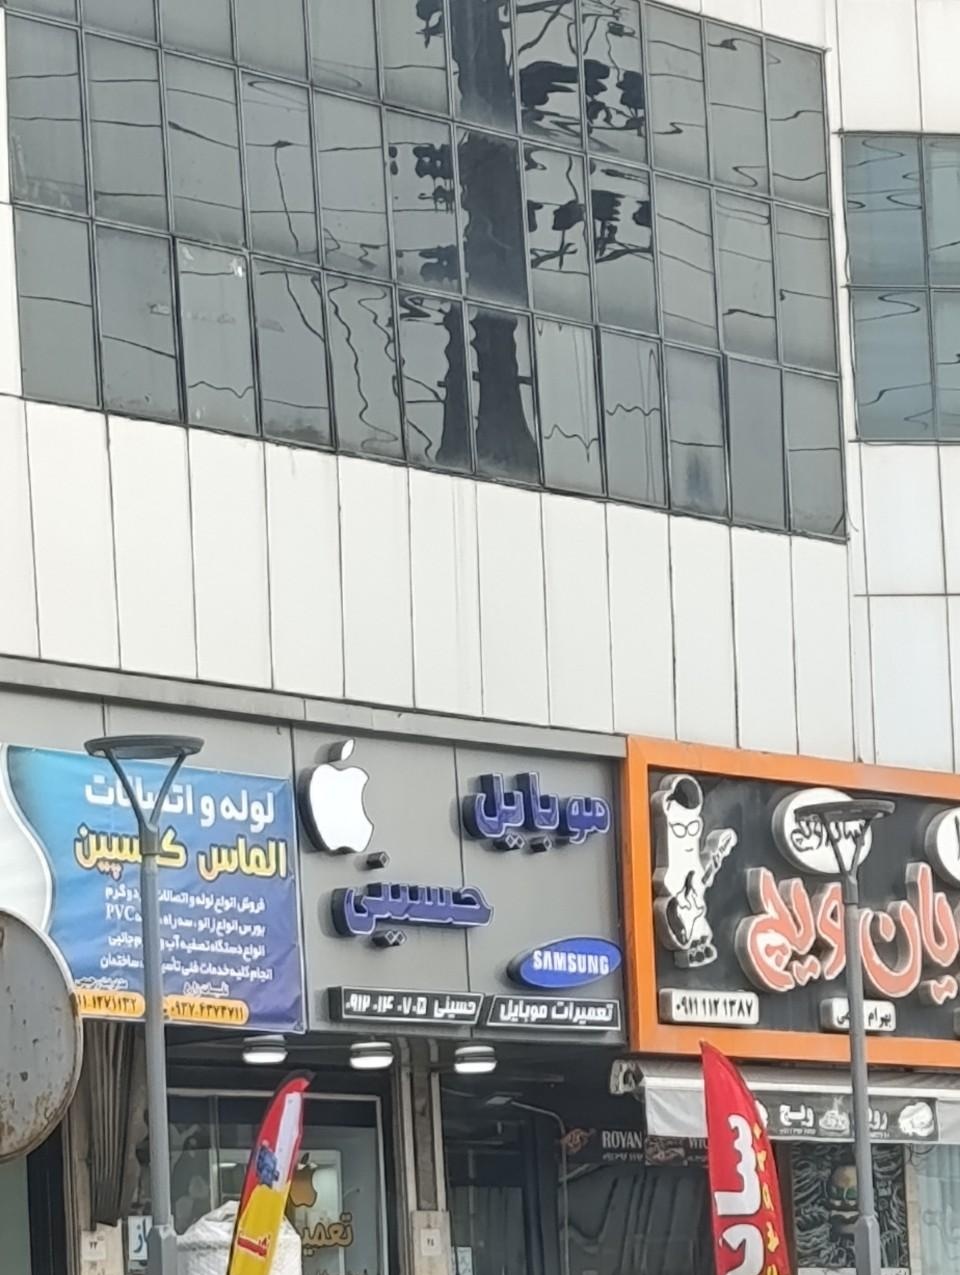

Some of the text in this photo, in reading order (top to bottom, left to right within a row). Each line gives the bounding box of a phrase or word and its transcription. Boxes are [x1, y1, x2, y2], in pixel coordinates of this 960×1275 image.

[199, 794, 216, 828] و
[220, 789, 275, 833] لوله
[473, 771, 611, 853] موبایل
[73, 822, 289, 882] الماس کسپین
[105, 902, 136, 921] PVC
[343, 850, 495, 947] حسینی
[745, 866, 846, 993] ویچ
[532, 949, 610, 975] SAMSUNG
[434, 994, 477, 1018] حسینی
[500, 999, 614, 1025] تعمیرات موبایل
[602, 1130, 642, 1150] ROYAN
